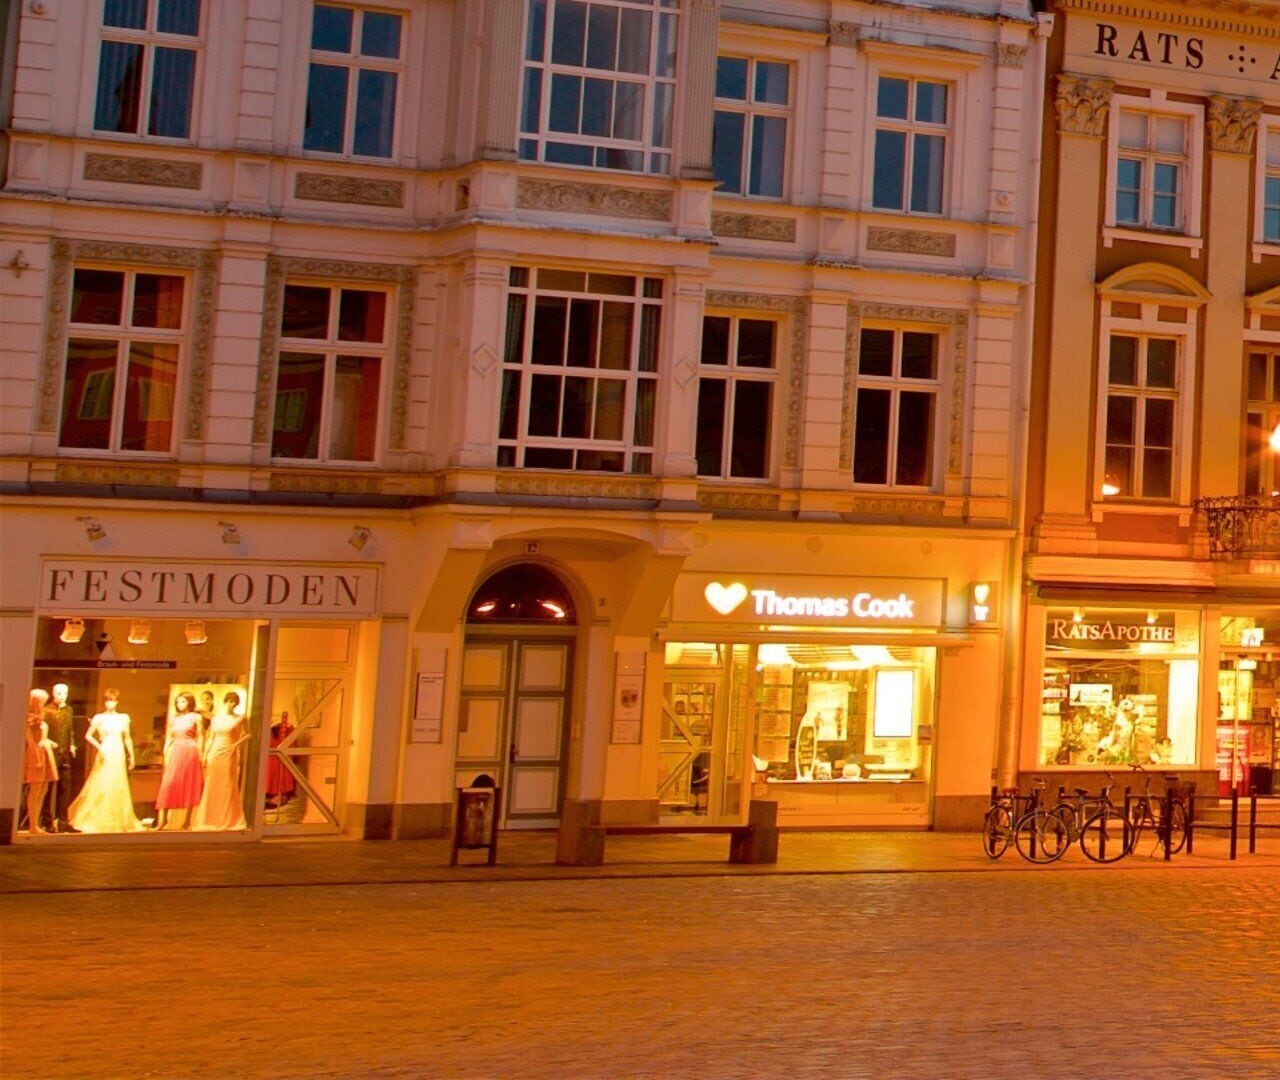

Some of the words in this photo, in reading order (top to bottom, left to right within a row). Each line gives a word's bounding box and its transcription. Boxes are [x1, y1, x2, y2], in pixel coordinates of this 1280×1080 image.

[1095, 23, 1204, 69] RATS
[527, 542, 538, 553] 12
[47, 569, 361, 606] FESTMODEN
[751, 590, 849, 617] Thomas
[852, 593, 914, 618] Cook
